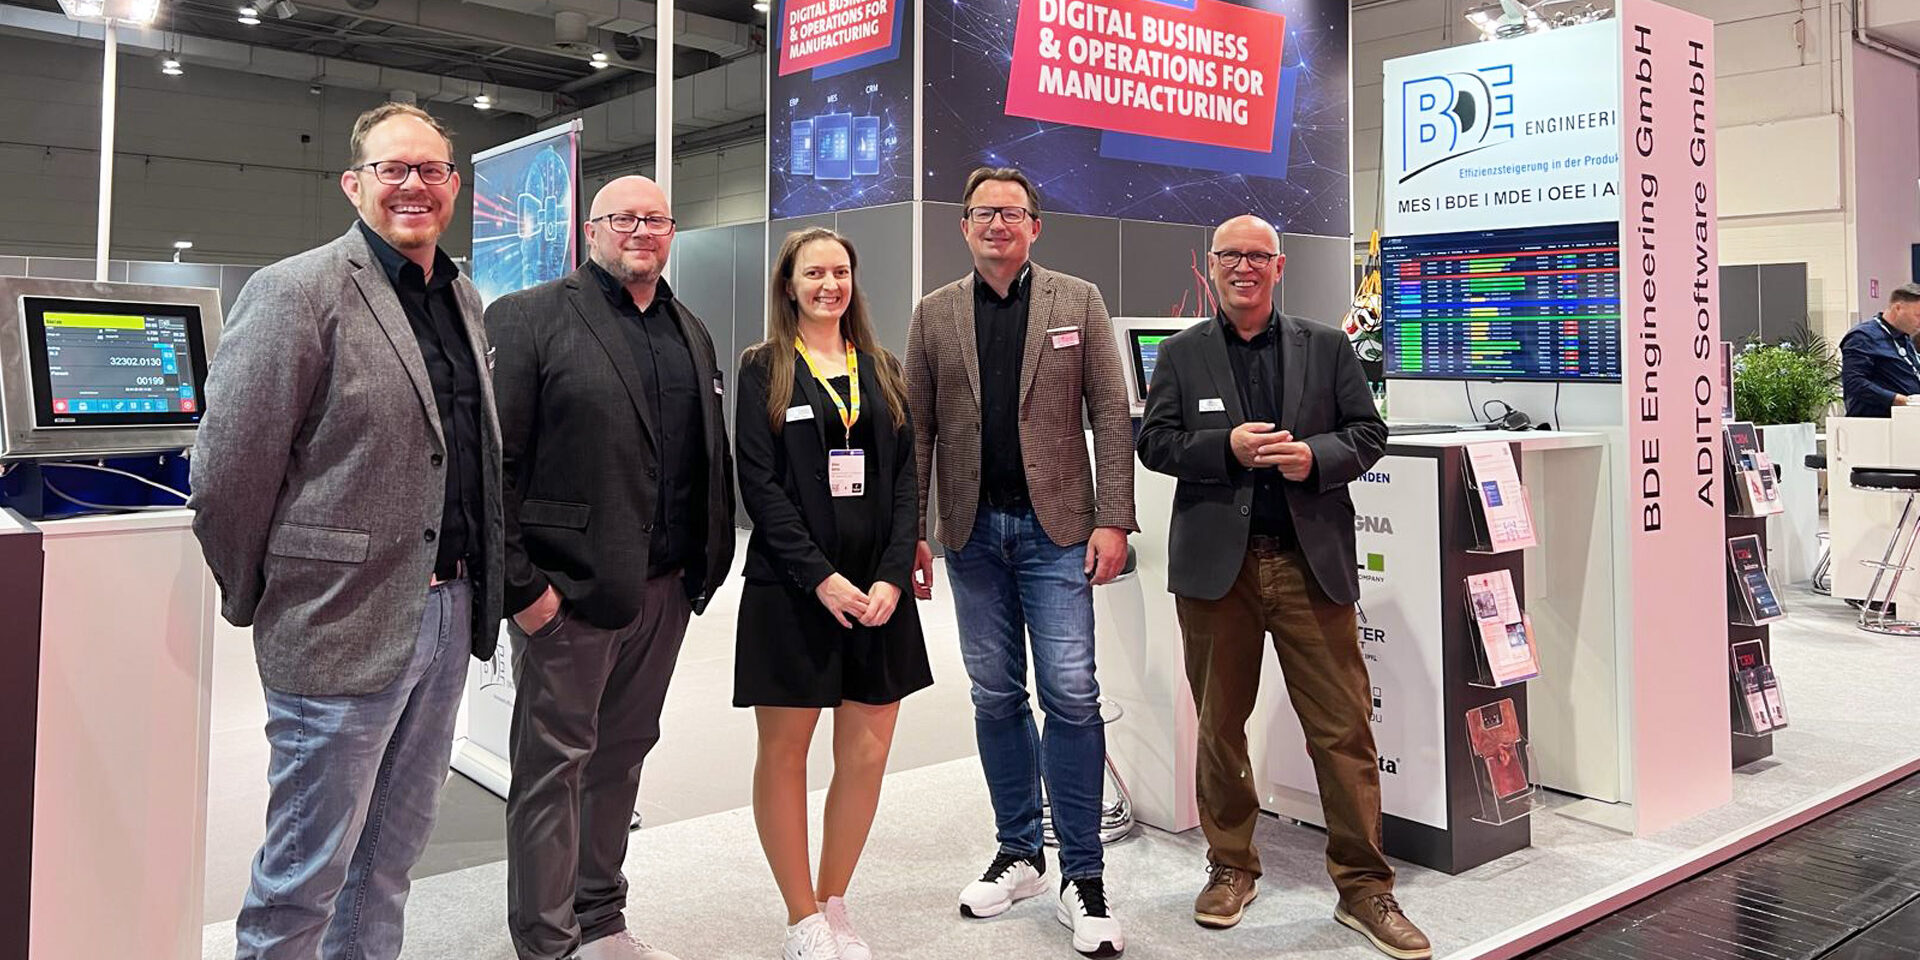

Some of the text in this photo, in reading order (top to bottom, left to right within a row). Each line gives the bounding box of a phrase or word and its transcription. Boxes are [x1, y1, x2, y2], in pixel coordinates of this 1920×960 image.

[789, 1, 828, 25] DIGITAL
[789, 1, 887, 41] & OPERATIONS FOR
[1039, 0, 1248, 62] DIGITAL BUSINESS
[789, 19, 879, 59] MANUFACTURING
[1038, 27, 1264, 97] & OPERATIONS FOR
[1038, 65, 1248, 126] MANUFACTURING
[1402, 64, 1514, 172] BDE
[1525, 110, 1616, 135] ENGINEERI
[1459, 159, 1549, 179] Effizienzsteigerung
[1552, 157, 1561, 169] in
[1565, 154, 1581, 168] der
[1398, 197, 1431, 213] MES
[1446, 193, 1479, 209] BDE
[1494, 189, 1532, 205] MDE
[1548, 184, 1586, 200] OEE
[1634, 25, 1661, 531] BDE Engineering GmbH
[1688, 40, 1714, 507] ADITO Software GmbH
[109, 356, 162, 367] 32302.0130
[136, 376, 165, 386] 00199
[1359, 472, 1391, 484] NDEN
